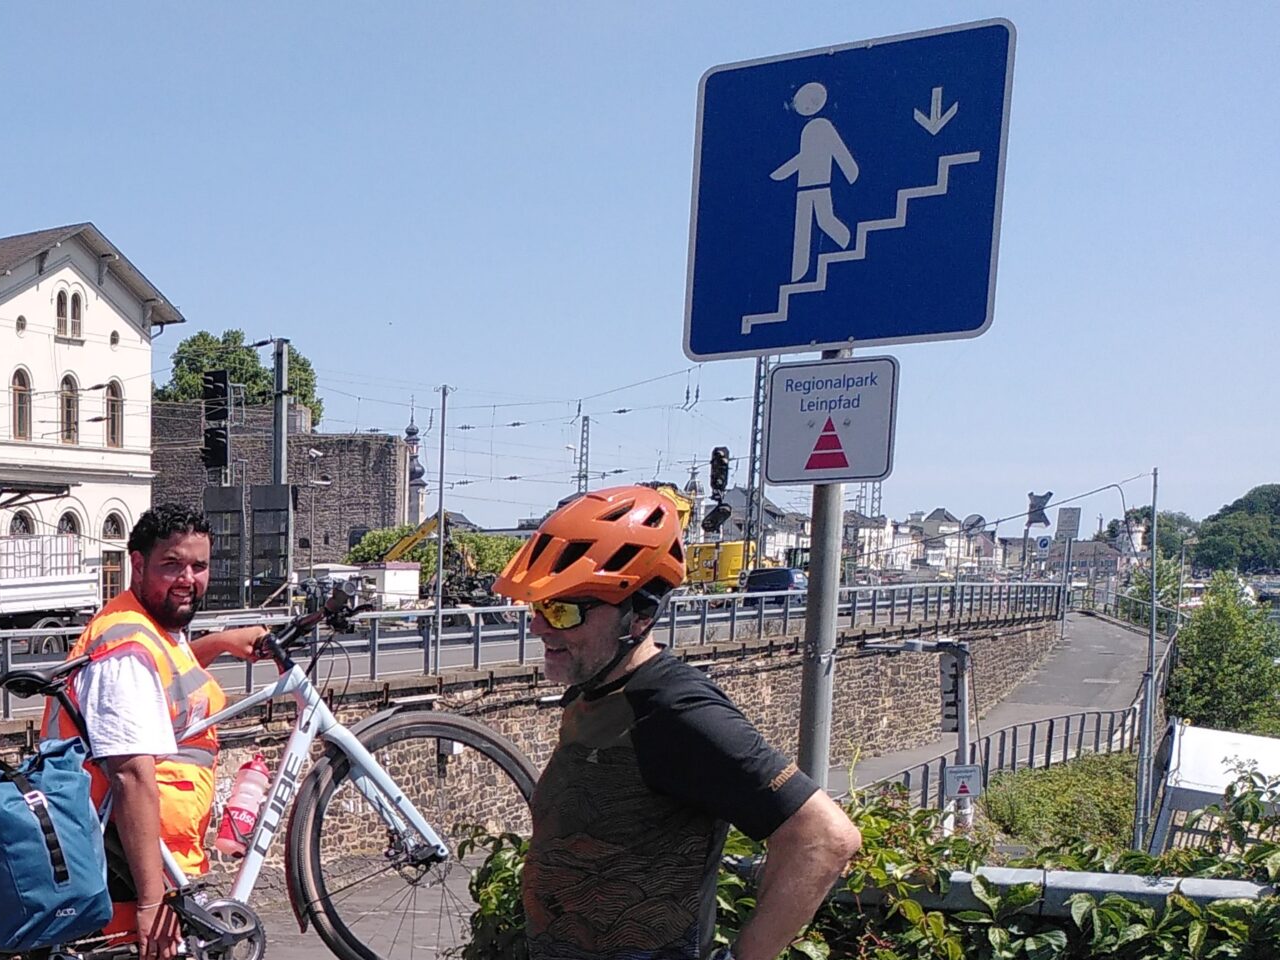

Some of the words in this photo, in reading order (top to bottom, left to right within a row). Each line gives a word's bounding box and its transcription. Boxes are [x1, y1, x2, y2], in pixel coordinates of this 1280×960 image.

[785, 372, 878, 395] Regionalpark
[800, 394, 860, 413] Leinpfad
[254, 752, 304, 858] CUBE
